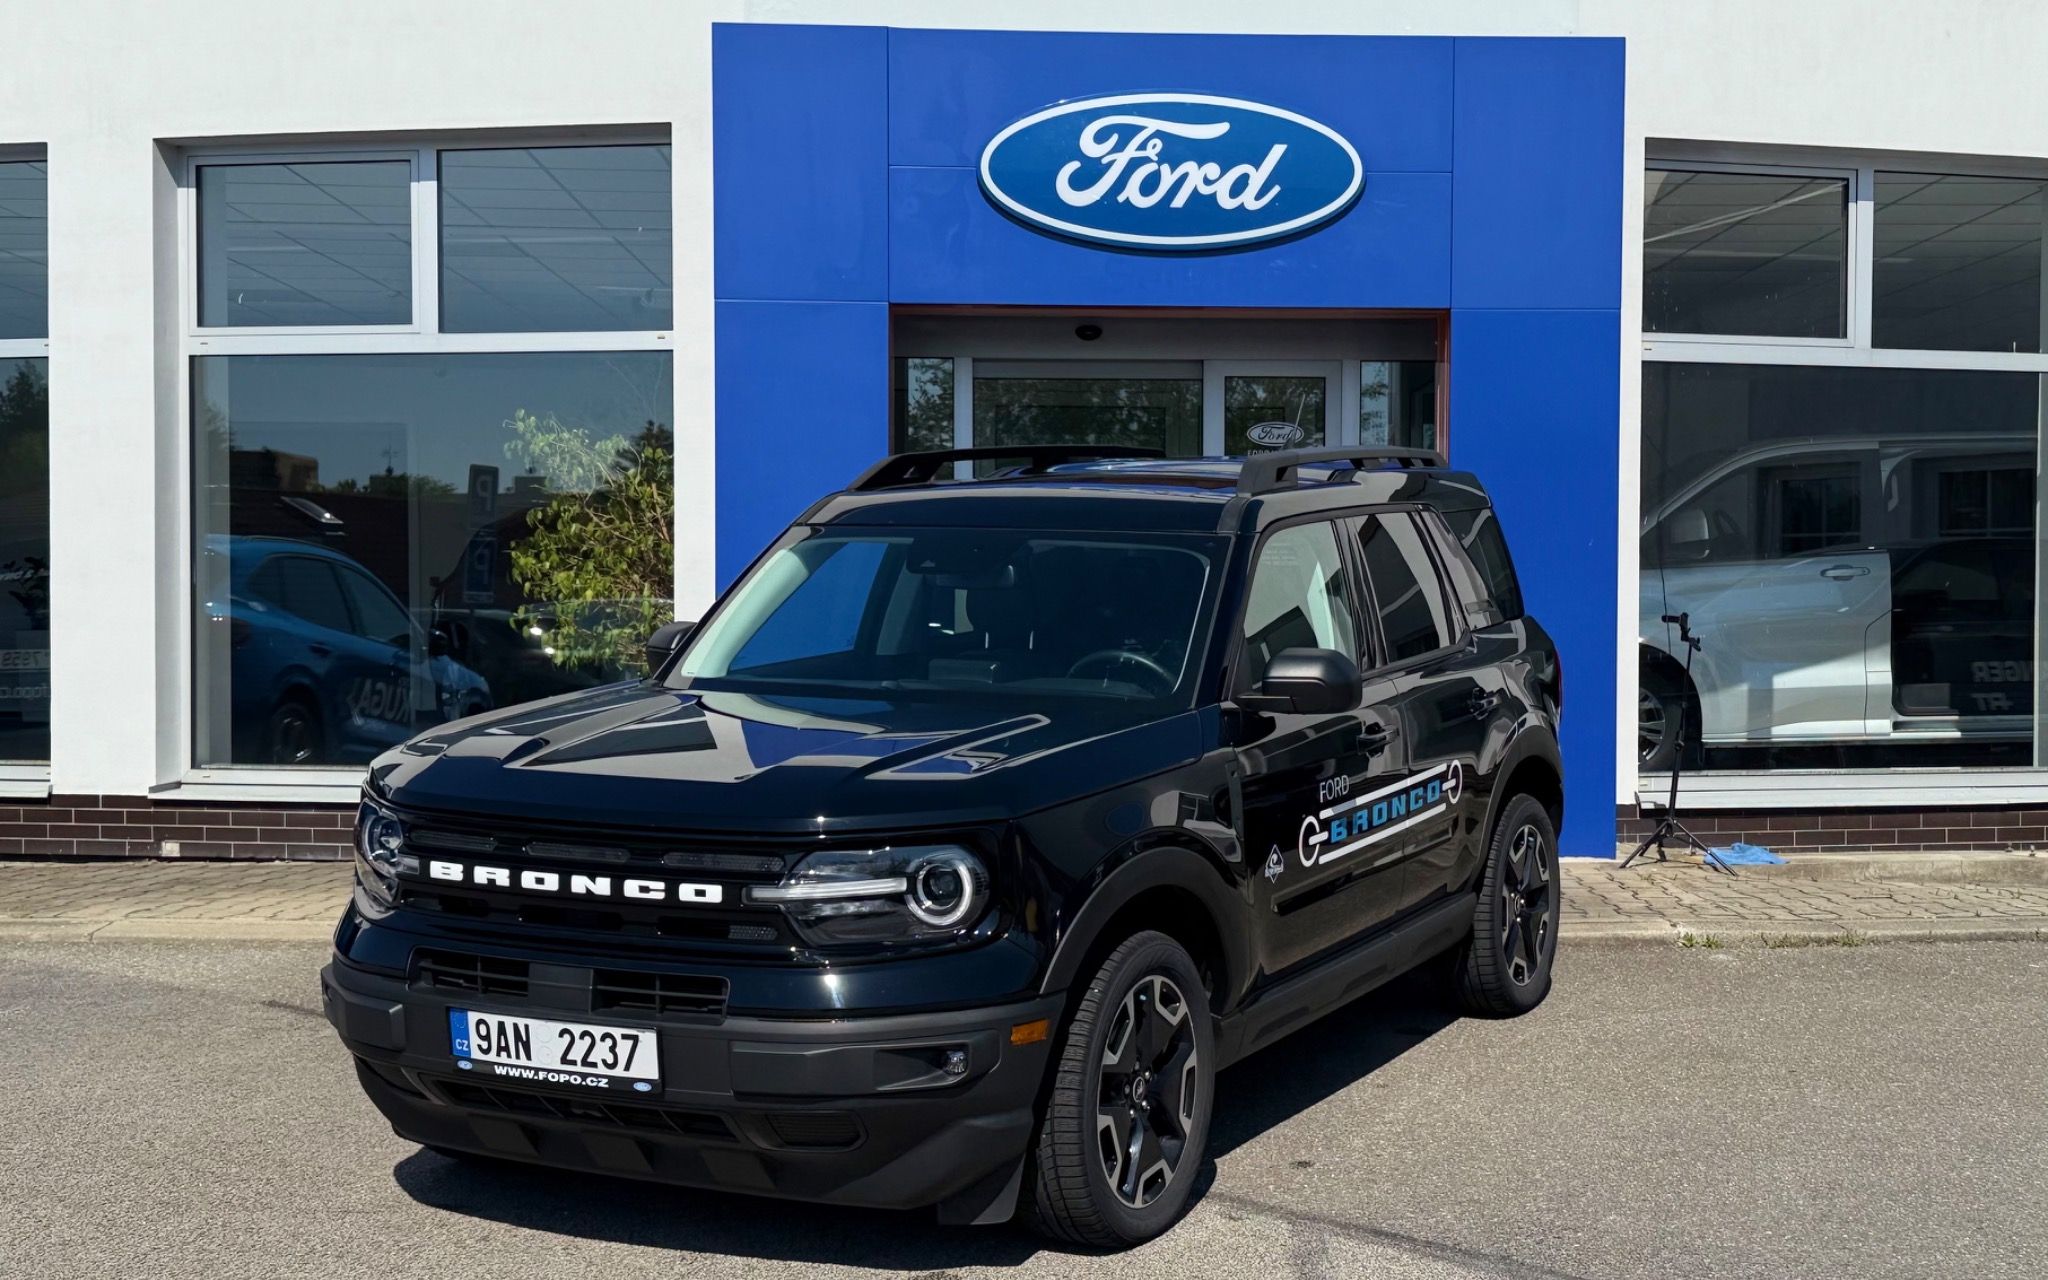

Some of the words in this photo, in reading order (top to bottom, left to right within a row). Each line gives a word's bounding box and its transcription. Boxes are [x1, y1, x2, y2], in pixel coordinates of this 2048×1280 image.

[1055, 115, 1287, 210] Ford
[1258, 426, 1294, 440] Ford
[1319, 774, 1350, 803] FORD
[1330, 779, 1440, 844] BRONCO
[429, 860, 723, 904] BRONCO
[455, 1039, 469, 1052] CZ
[475, 1018, 532, 1061] 9AN
[558, 1028, 640, 1072] 2237
[494, 1065, 609, 1088] WWW.FOPO.CZ
